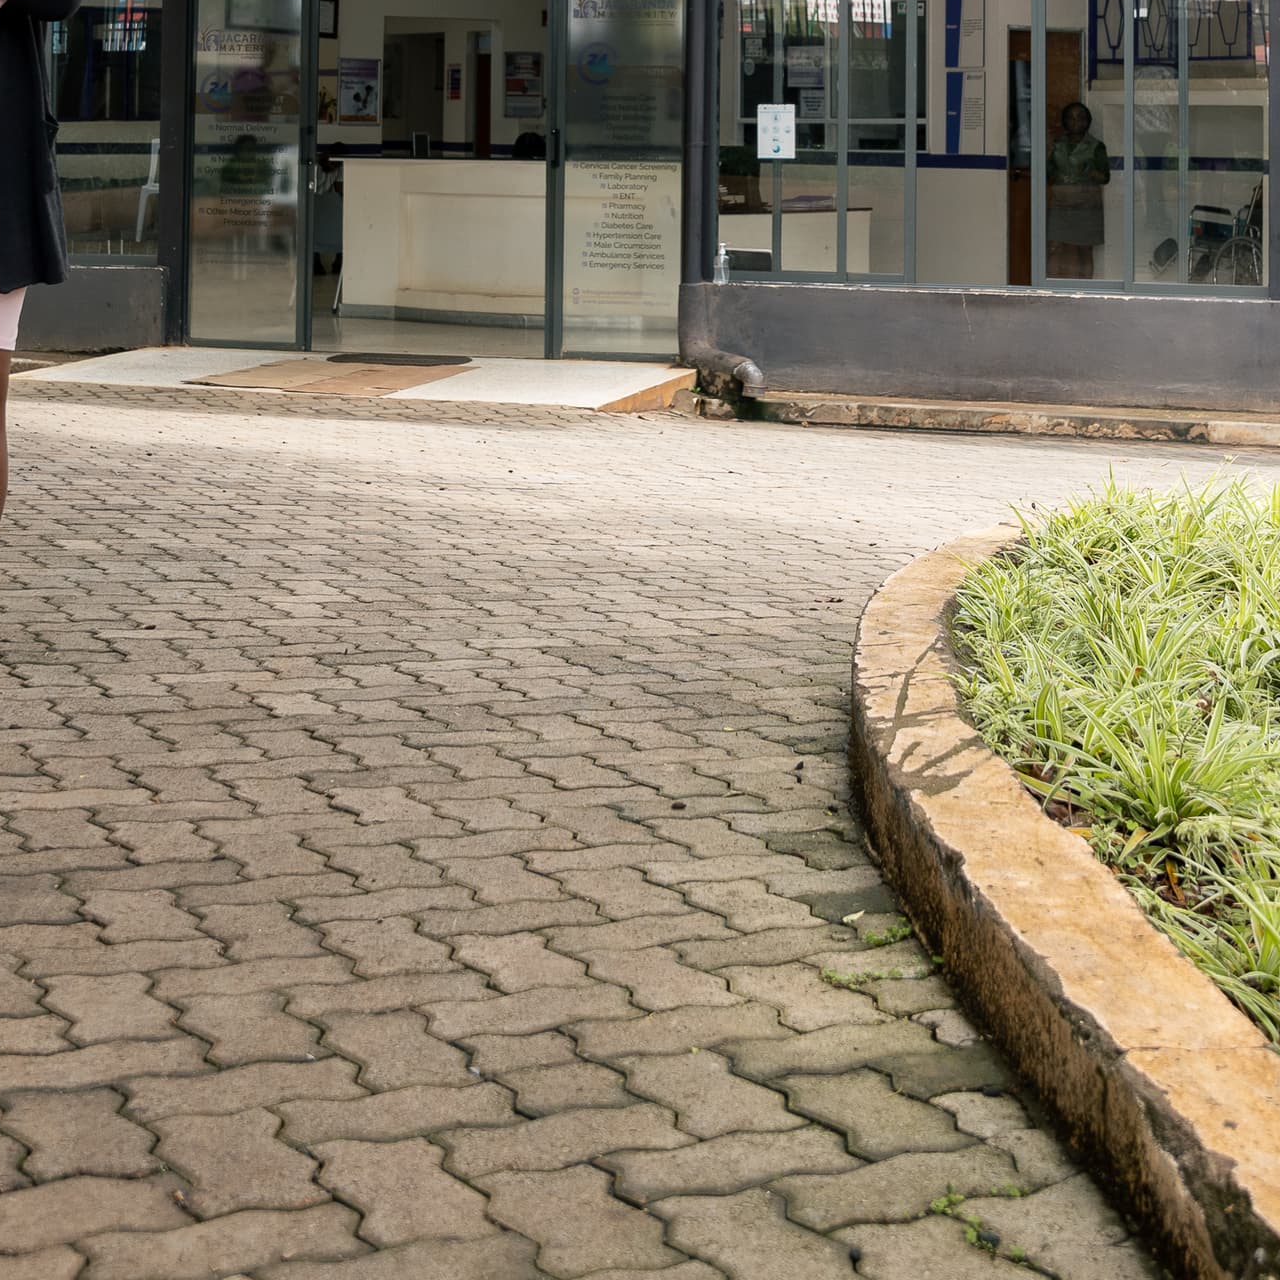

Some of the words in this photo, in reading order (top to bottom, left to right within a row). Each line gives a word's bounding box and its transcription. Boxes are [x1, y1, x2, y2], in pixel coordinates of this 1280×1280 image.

[580, 162, 609, 170] Cervical
[611, 162, 638, 170] Cancer
[639, 162, 678, 172] Screening
[599, 172, 624, 182] Family
[625, 172, 658, 182] Planning
[607, 182, 649, 192] Laboratory
[619, 192, 637, 200] ENT
[609, 202, 646, 212] Pharmacy
[611, 212, 645, 220] Nutrition
[601, 222, 634, 230] Diabetes
[636, 222, 654, 230] Care
[592, 232, 643, 241] Hypertension
[593, 241, 613, 250] Male
[589, 251, 632, 260] Ambulance
[633, 252, 665, 260] Services
[589, 261, 632, 271] Emergency
[632, 261, 665, 270] Services
